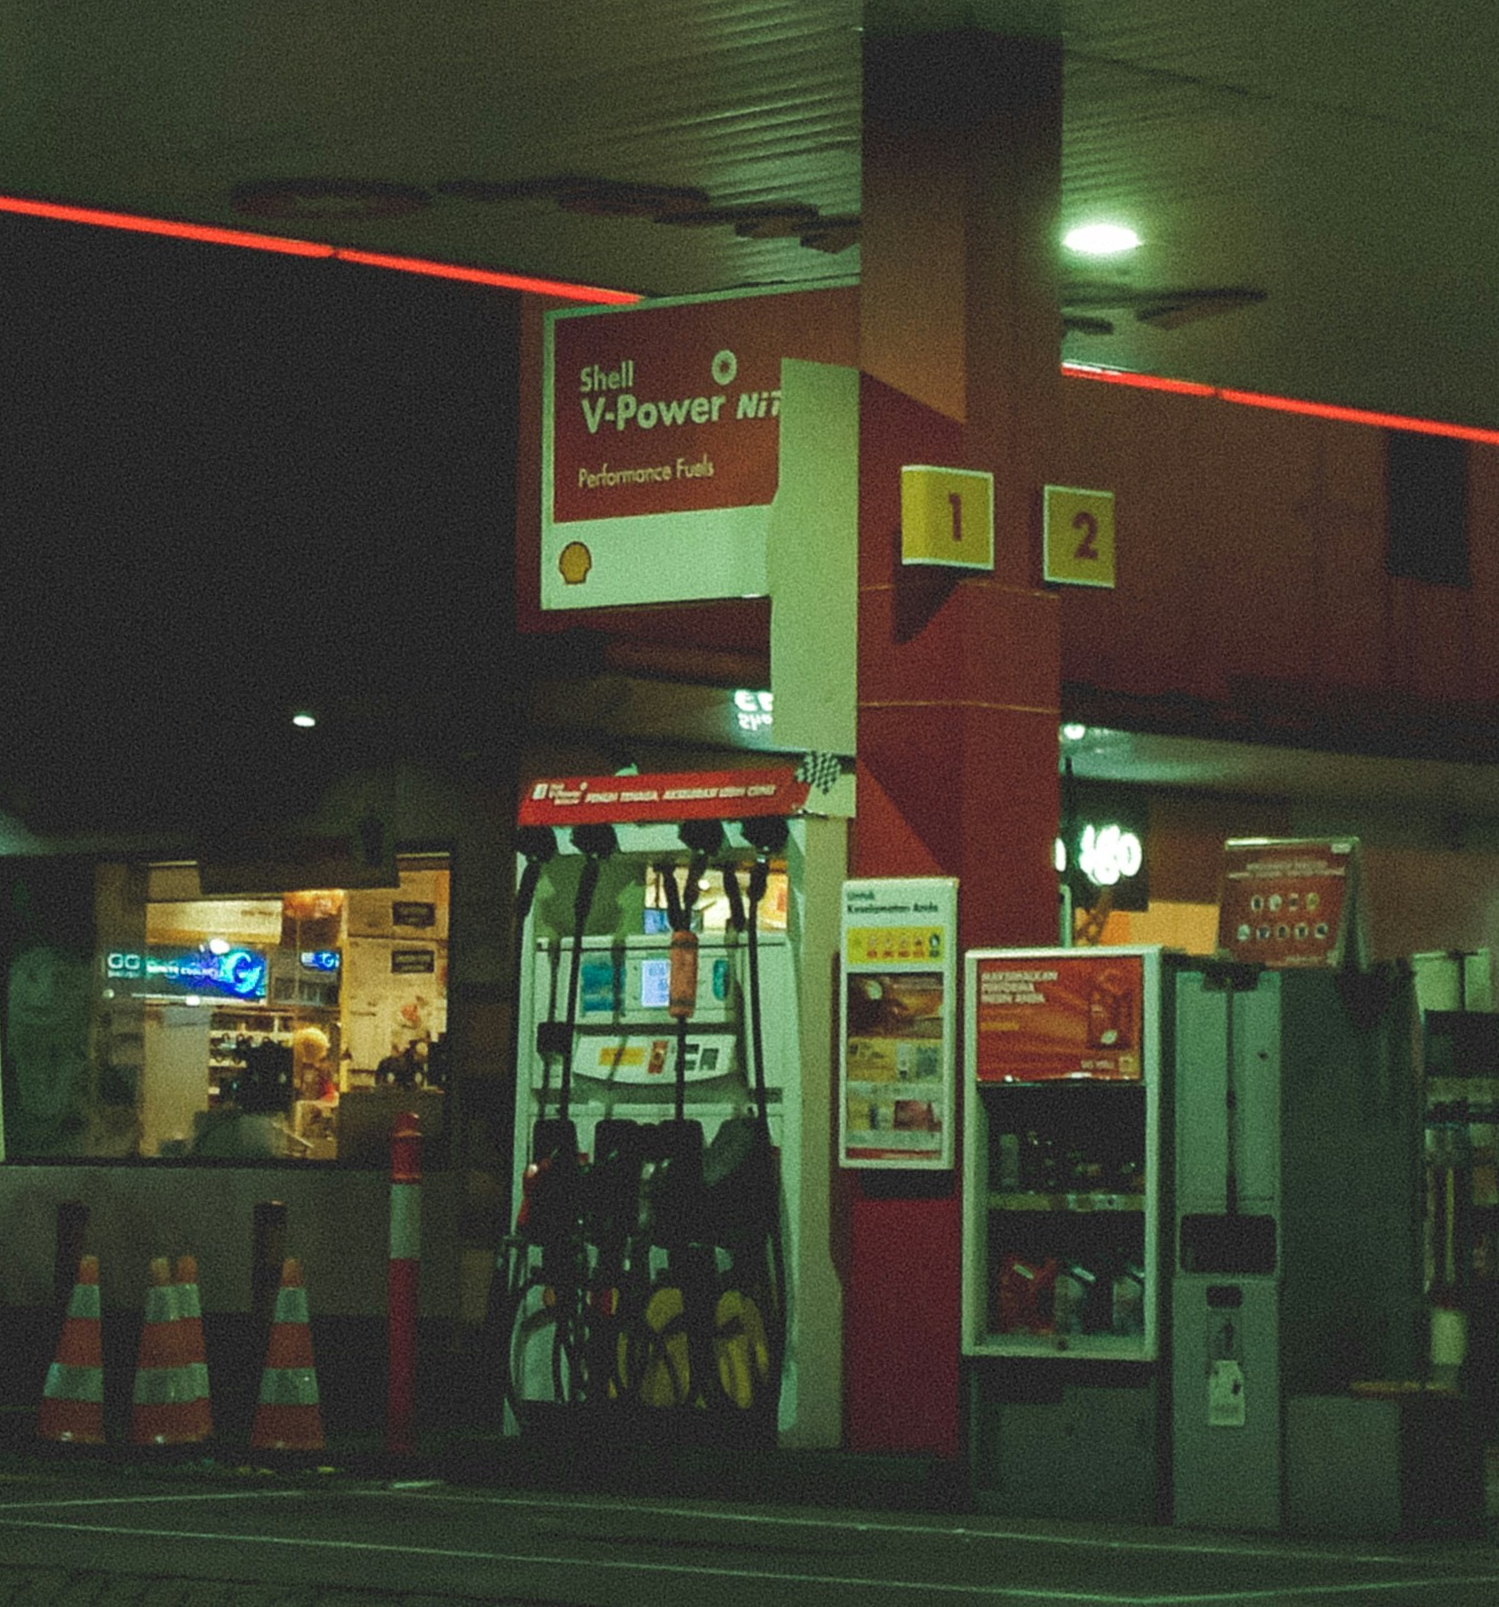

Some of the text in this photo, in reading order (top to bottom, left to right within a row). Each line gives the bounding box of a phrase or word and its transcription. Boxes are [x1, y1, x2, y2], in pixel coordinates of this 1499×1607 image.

[580, 359, 634, 393] Shell
[581, 390, 782, 434] V-Power NiT
[579, 454, 715, 489] Performance Fuels
[948, 493, 963, 542] 1
[1073, 511, 1098, 560] 2
